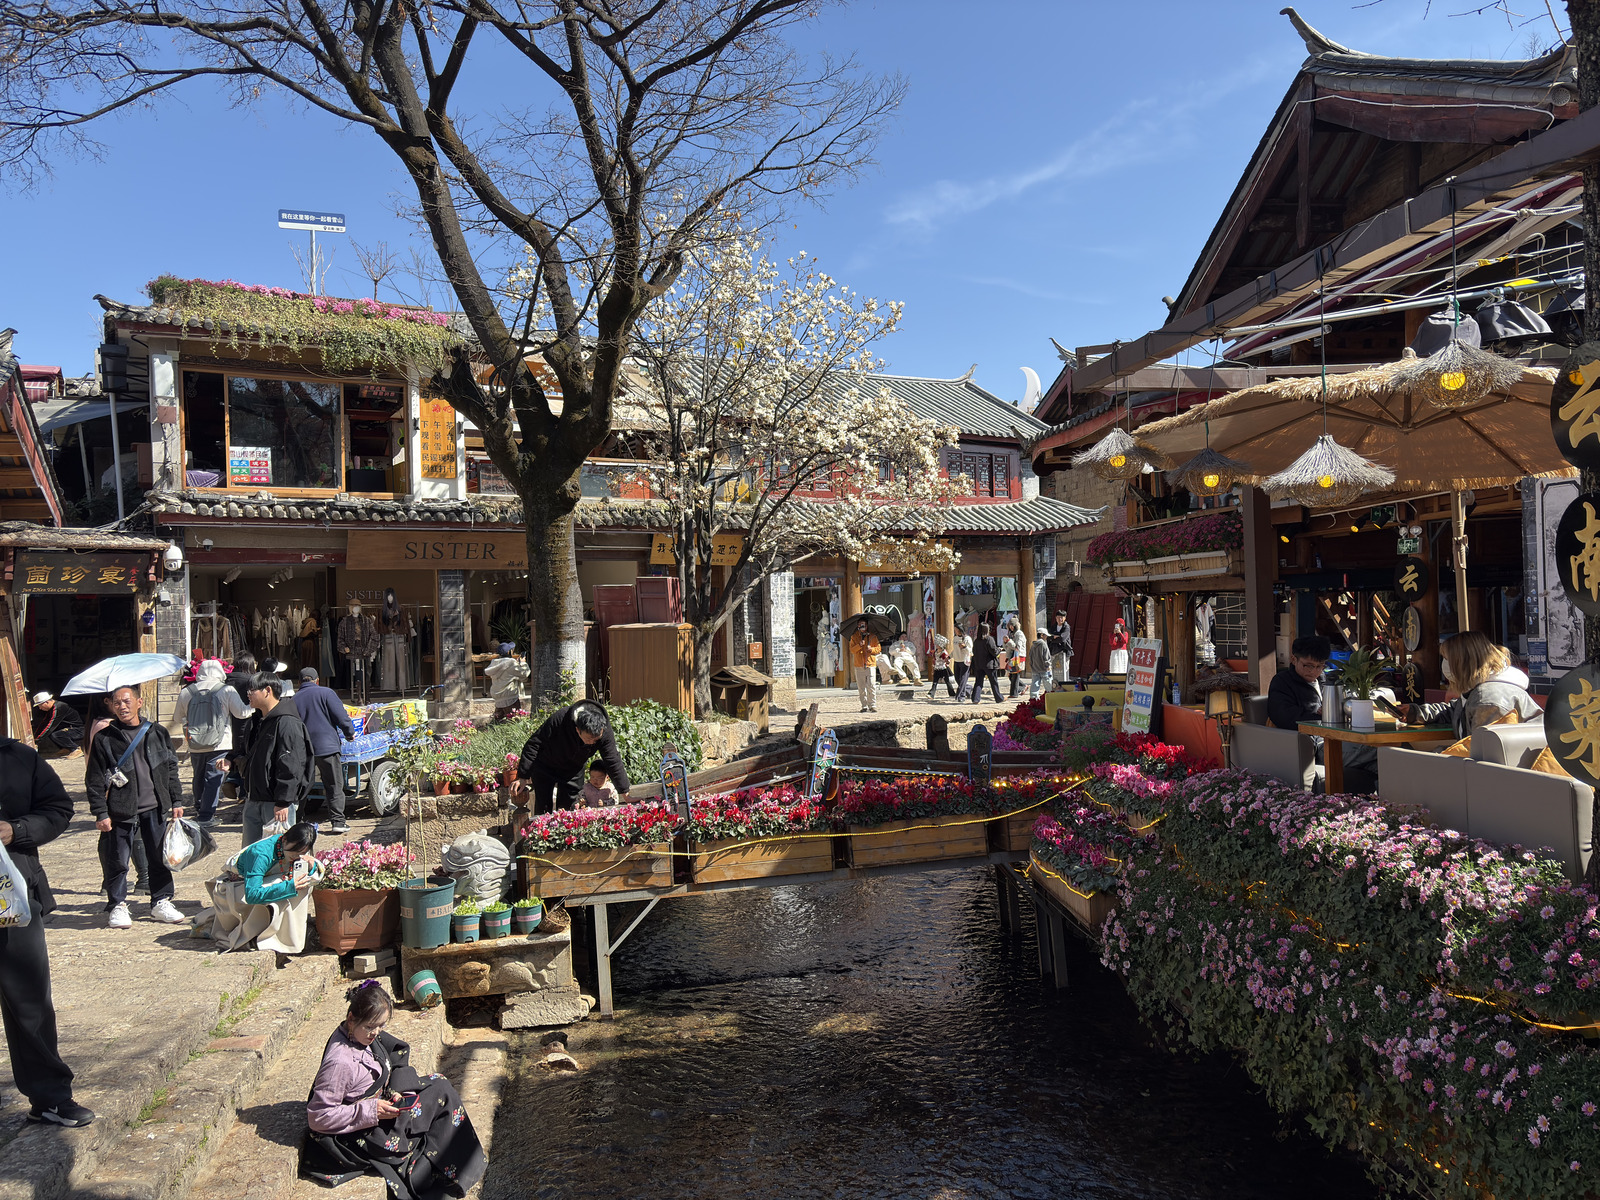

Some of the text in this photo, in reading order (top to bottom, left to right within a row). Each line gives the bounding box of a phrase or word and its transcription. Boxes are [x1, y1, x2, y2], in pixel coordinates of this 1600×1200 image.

[282, 212, 343, 223] 我在这里等你一起看雪山
[421, 421, 454, 430] 下午茶
[422, 443, 454, 452] 看雪山
[422, 453, 455, 463] 民谣现场
[422, 464, 455, 473] 网红打卡
[404, 541, 498, 561] SISTER
[25, 565, 126, 585] 菌珍宴
[1135, 650, 1152, 665] 下午茶
